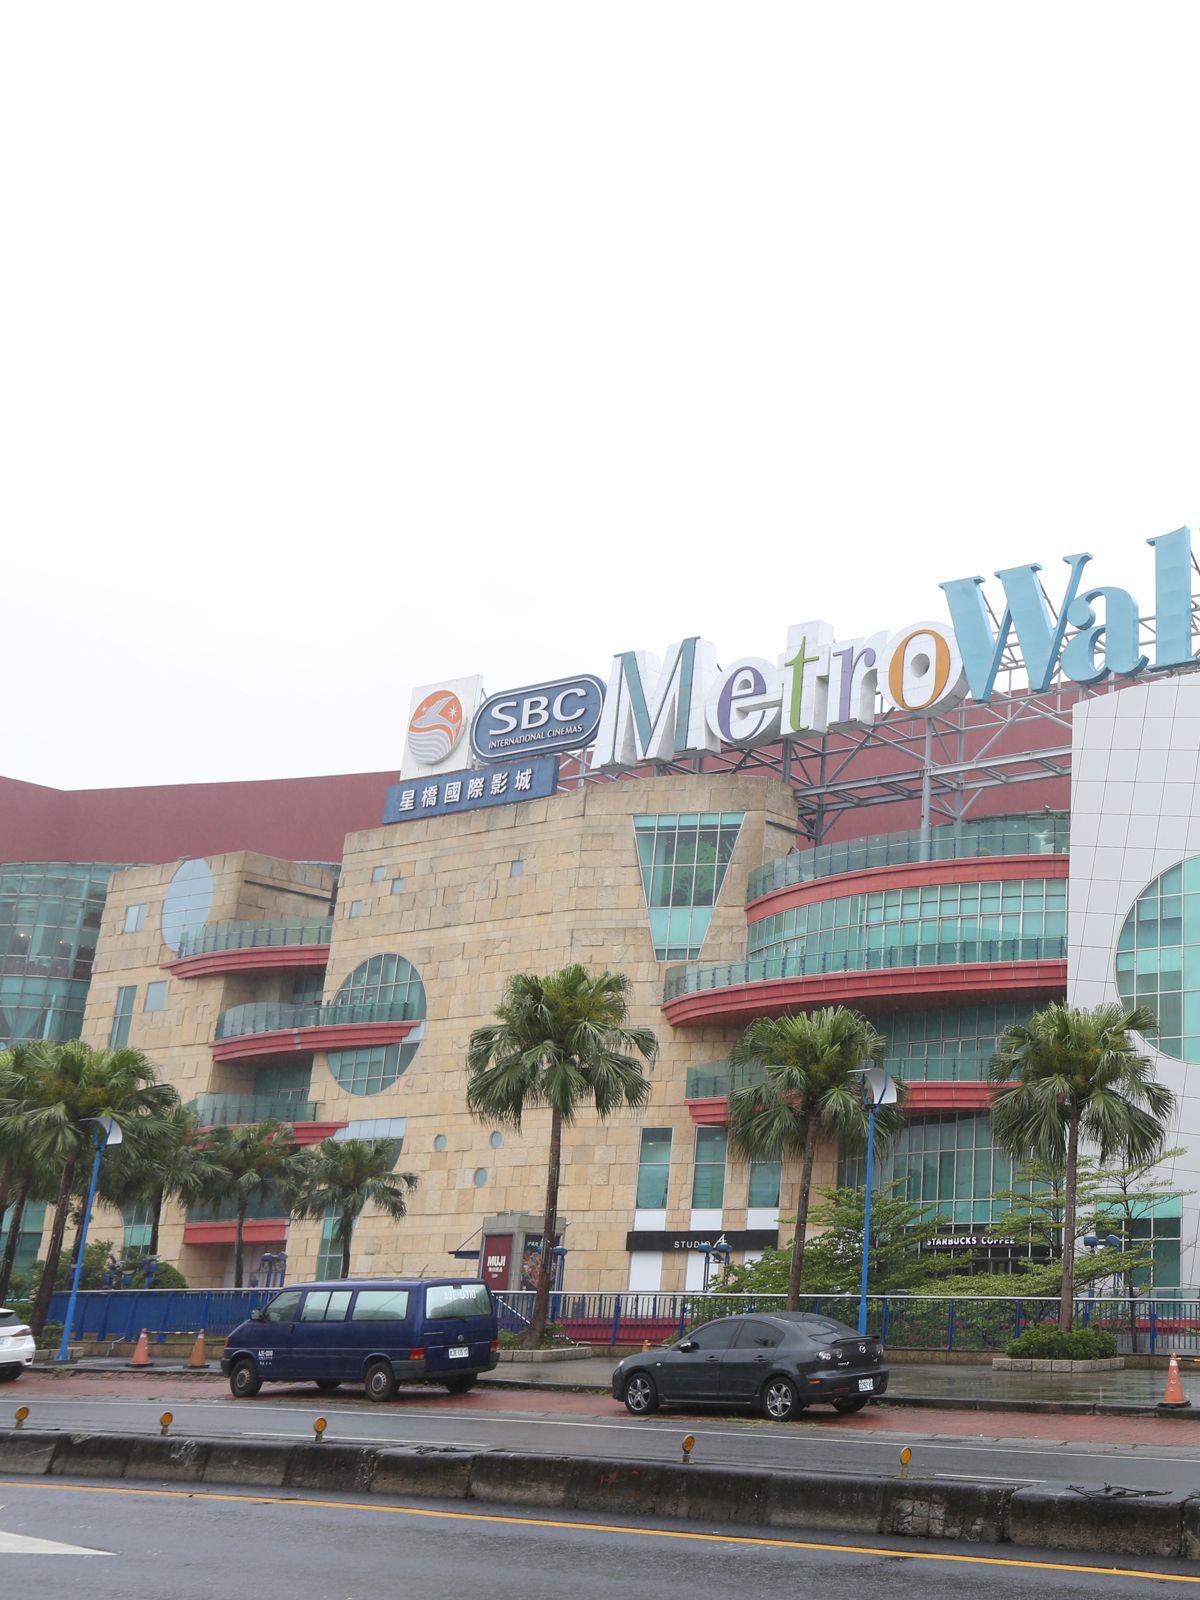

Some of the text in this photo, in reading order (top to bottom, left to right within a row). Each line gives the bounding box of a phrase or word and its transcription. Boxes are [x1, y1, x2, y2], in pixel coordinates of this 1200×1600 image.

[489, 687, 587, 735] SBC
[488, 724, 583, 750] INTERNATIONAL CINEMAS
[398, 768, 534, 812] 星橋國際影城
[673, 1240, 711, 1249] STUDO
[927, 1236, 977, 1246] STARBUCKS
[487, 1255, 507, 1267] MUJI
